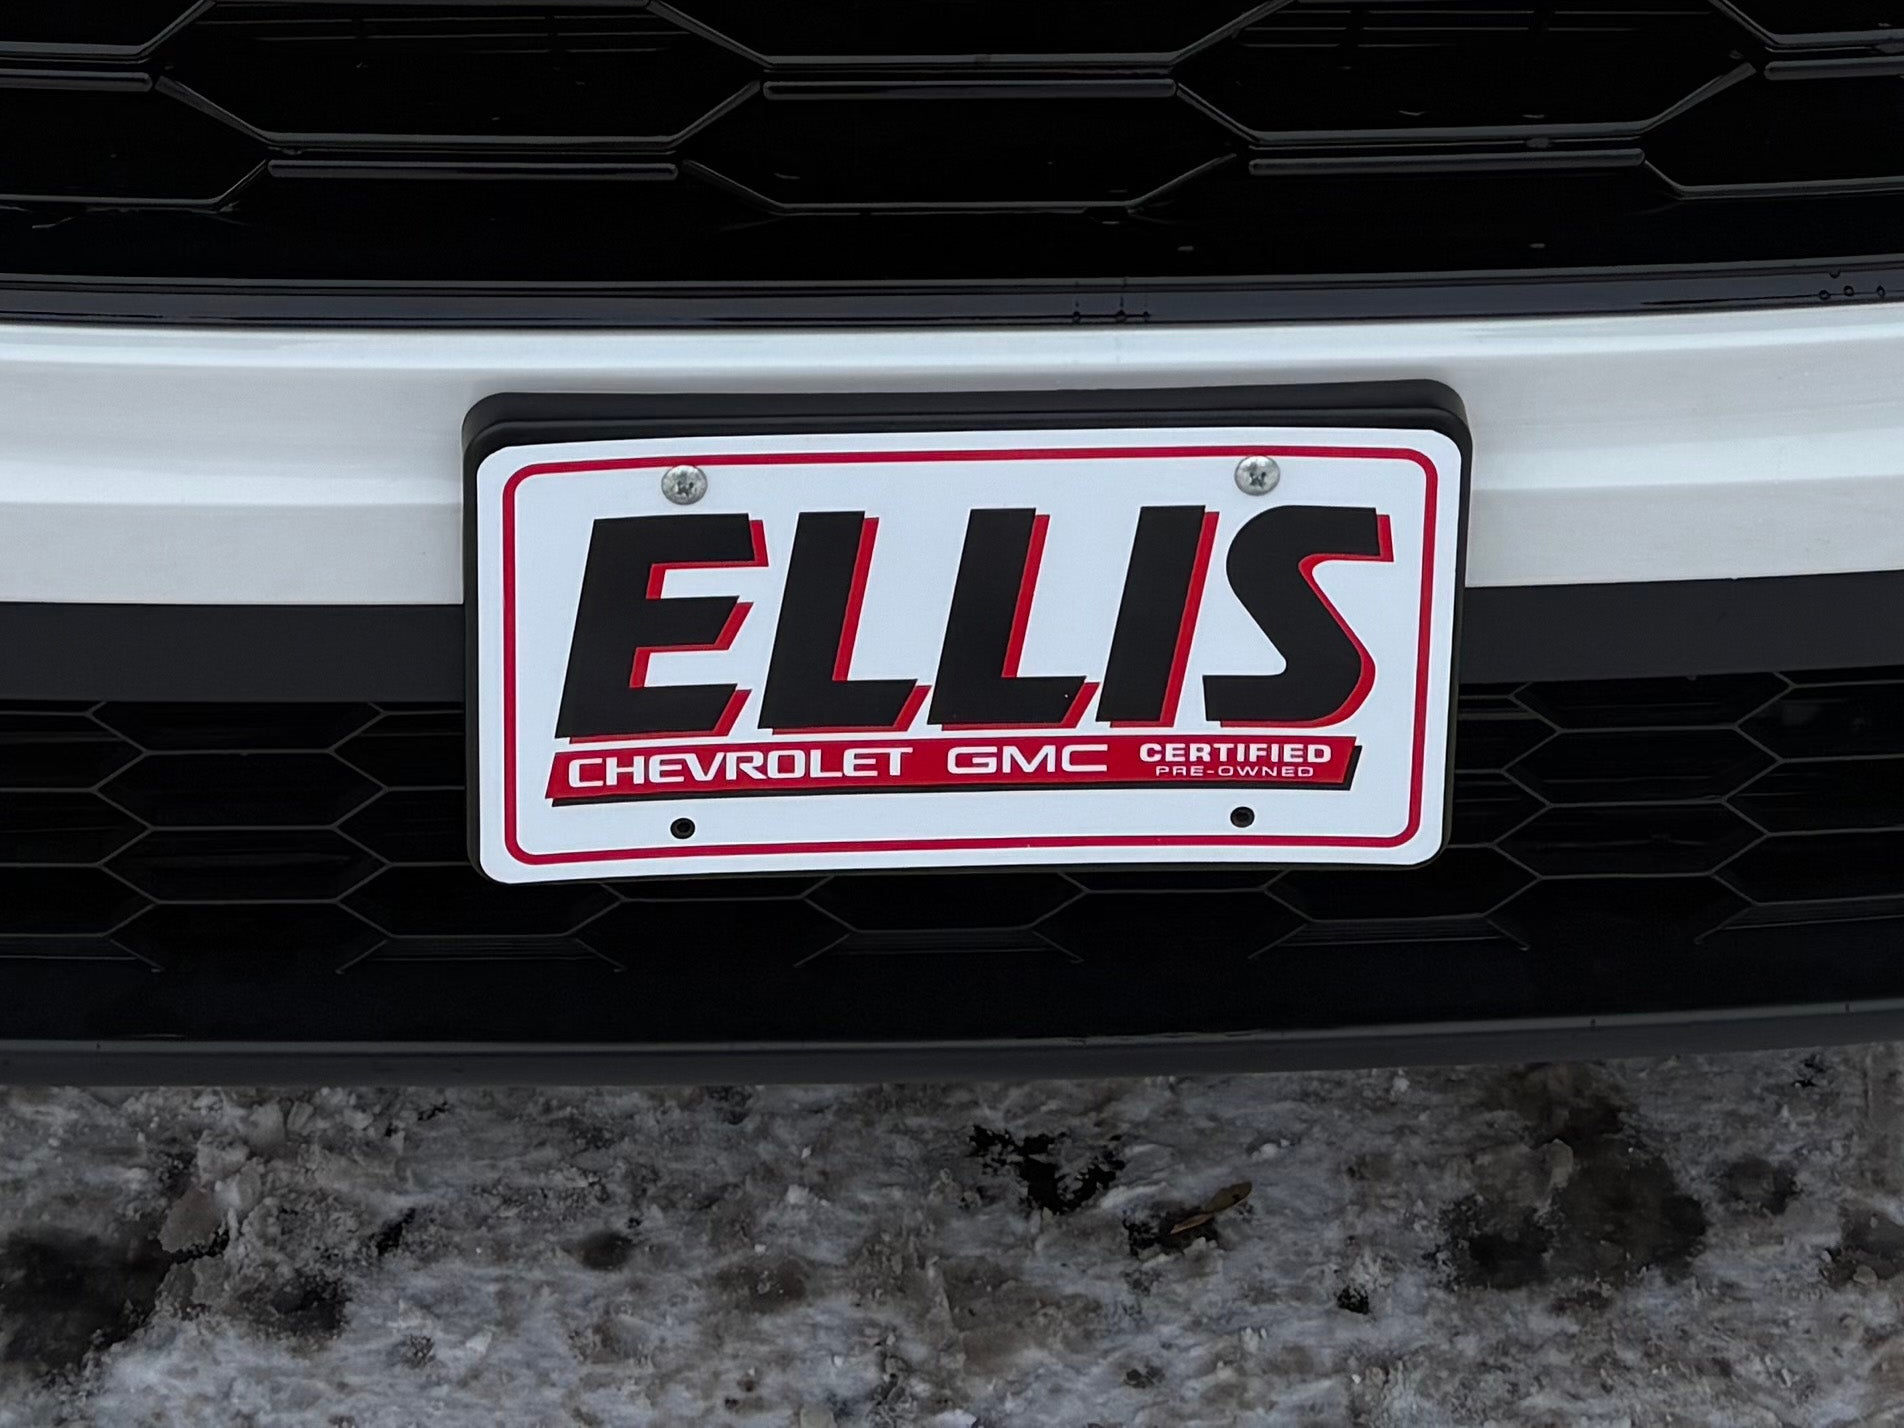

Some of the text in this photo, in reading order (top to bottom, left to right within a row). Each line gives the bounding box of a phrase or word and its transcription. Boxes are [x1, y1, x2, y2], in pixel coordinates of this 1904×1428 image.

[553, 504, 1395, 744] ELLIS
[566, 743, 1110, 790] CHEVROLET GMC
[1138, 741, 1333, 765] CERTIFIED
[1154, 765, 1315, 778] PRE-OWNED
